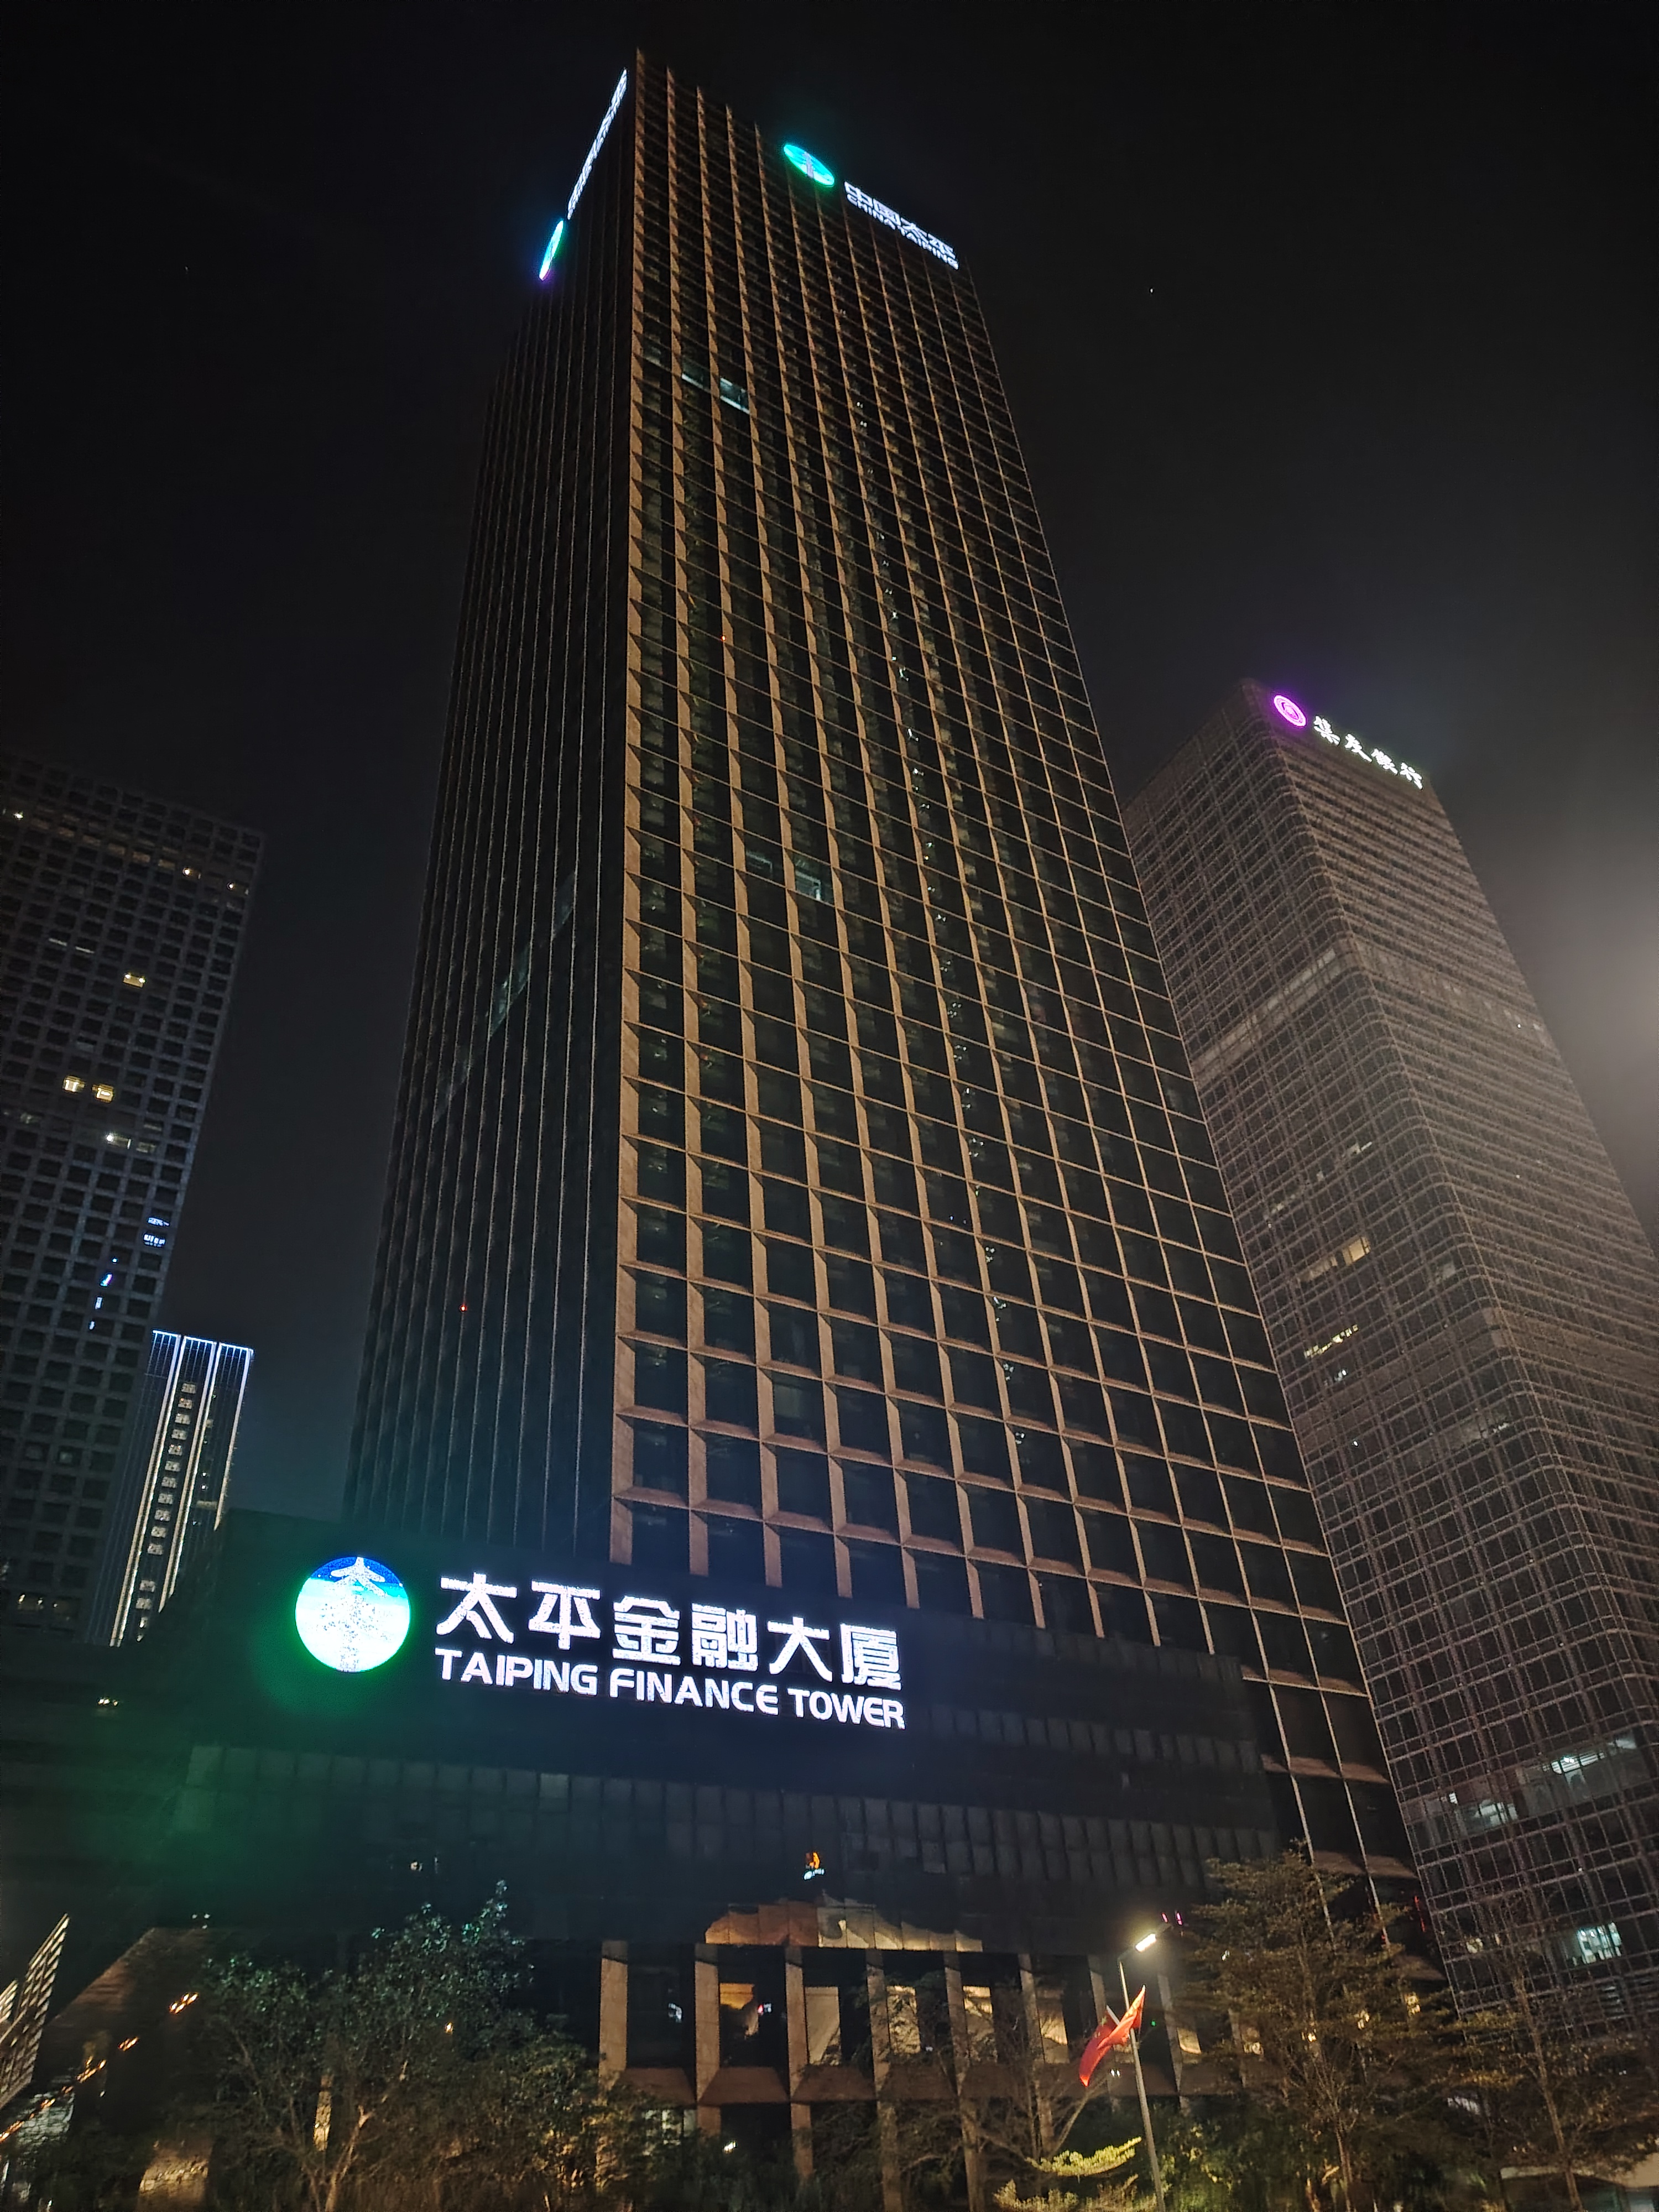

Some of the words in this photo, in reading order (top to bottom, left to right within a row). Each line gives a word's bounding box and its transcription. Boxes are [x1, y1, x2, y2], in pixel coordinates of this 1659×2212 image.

[847, 194, 896, 229] CHINA
[436, 1572, 901, 1691] 太平金融大厦
[435, 1647, 599, 1695] TAIPING
[609, 1668, 779, 1716] FINANCE
[787, 1688, 906, 1730] TOWER
